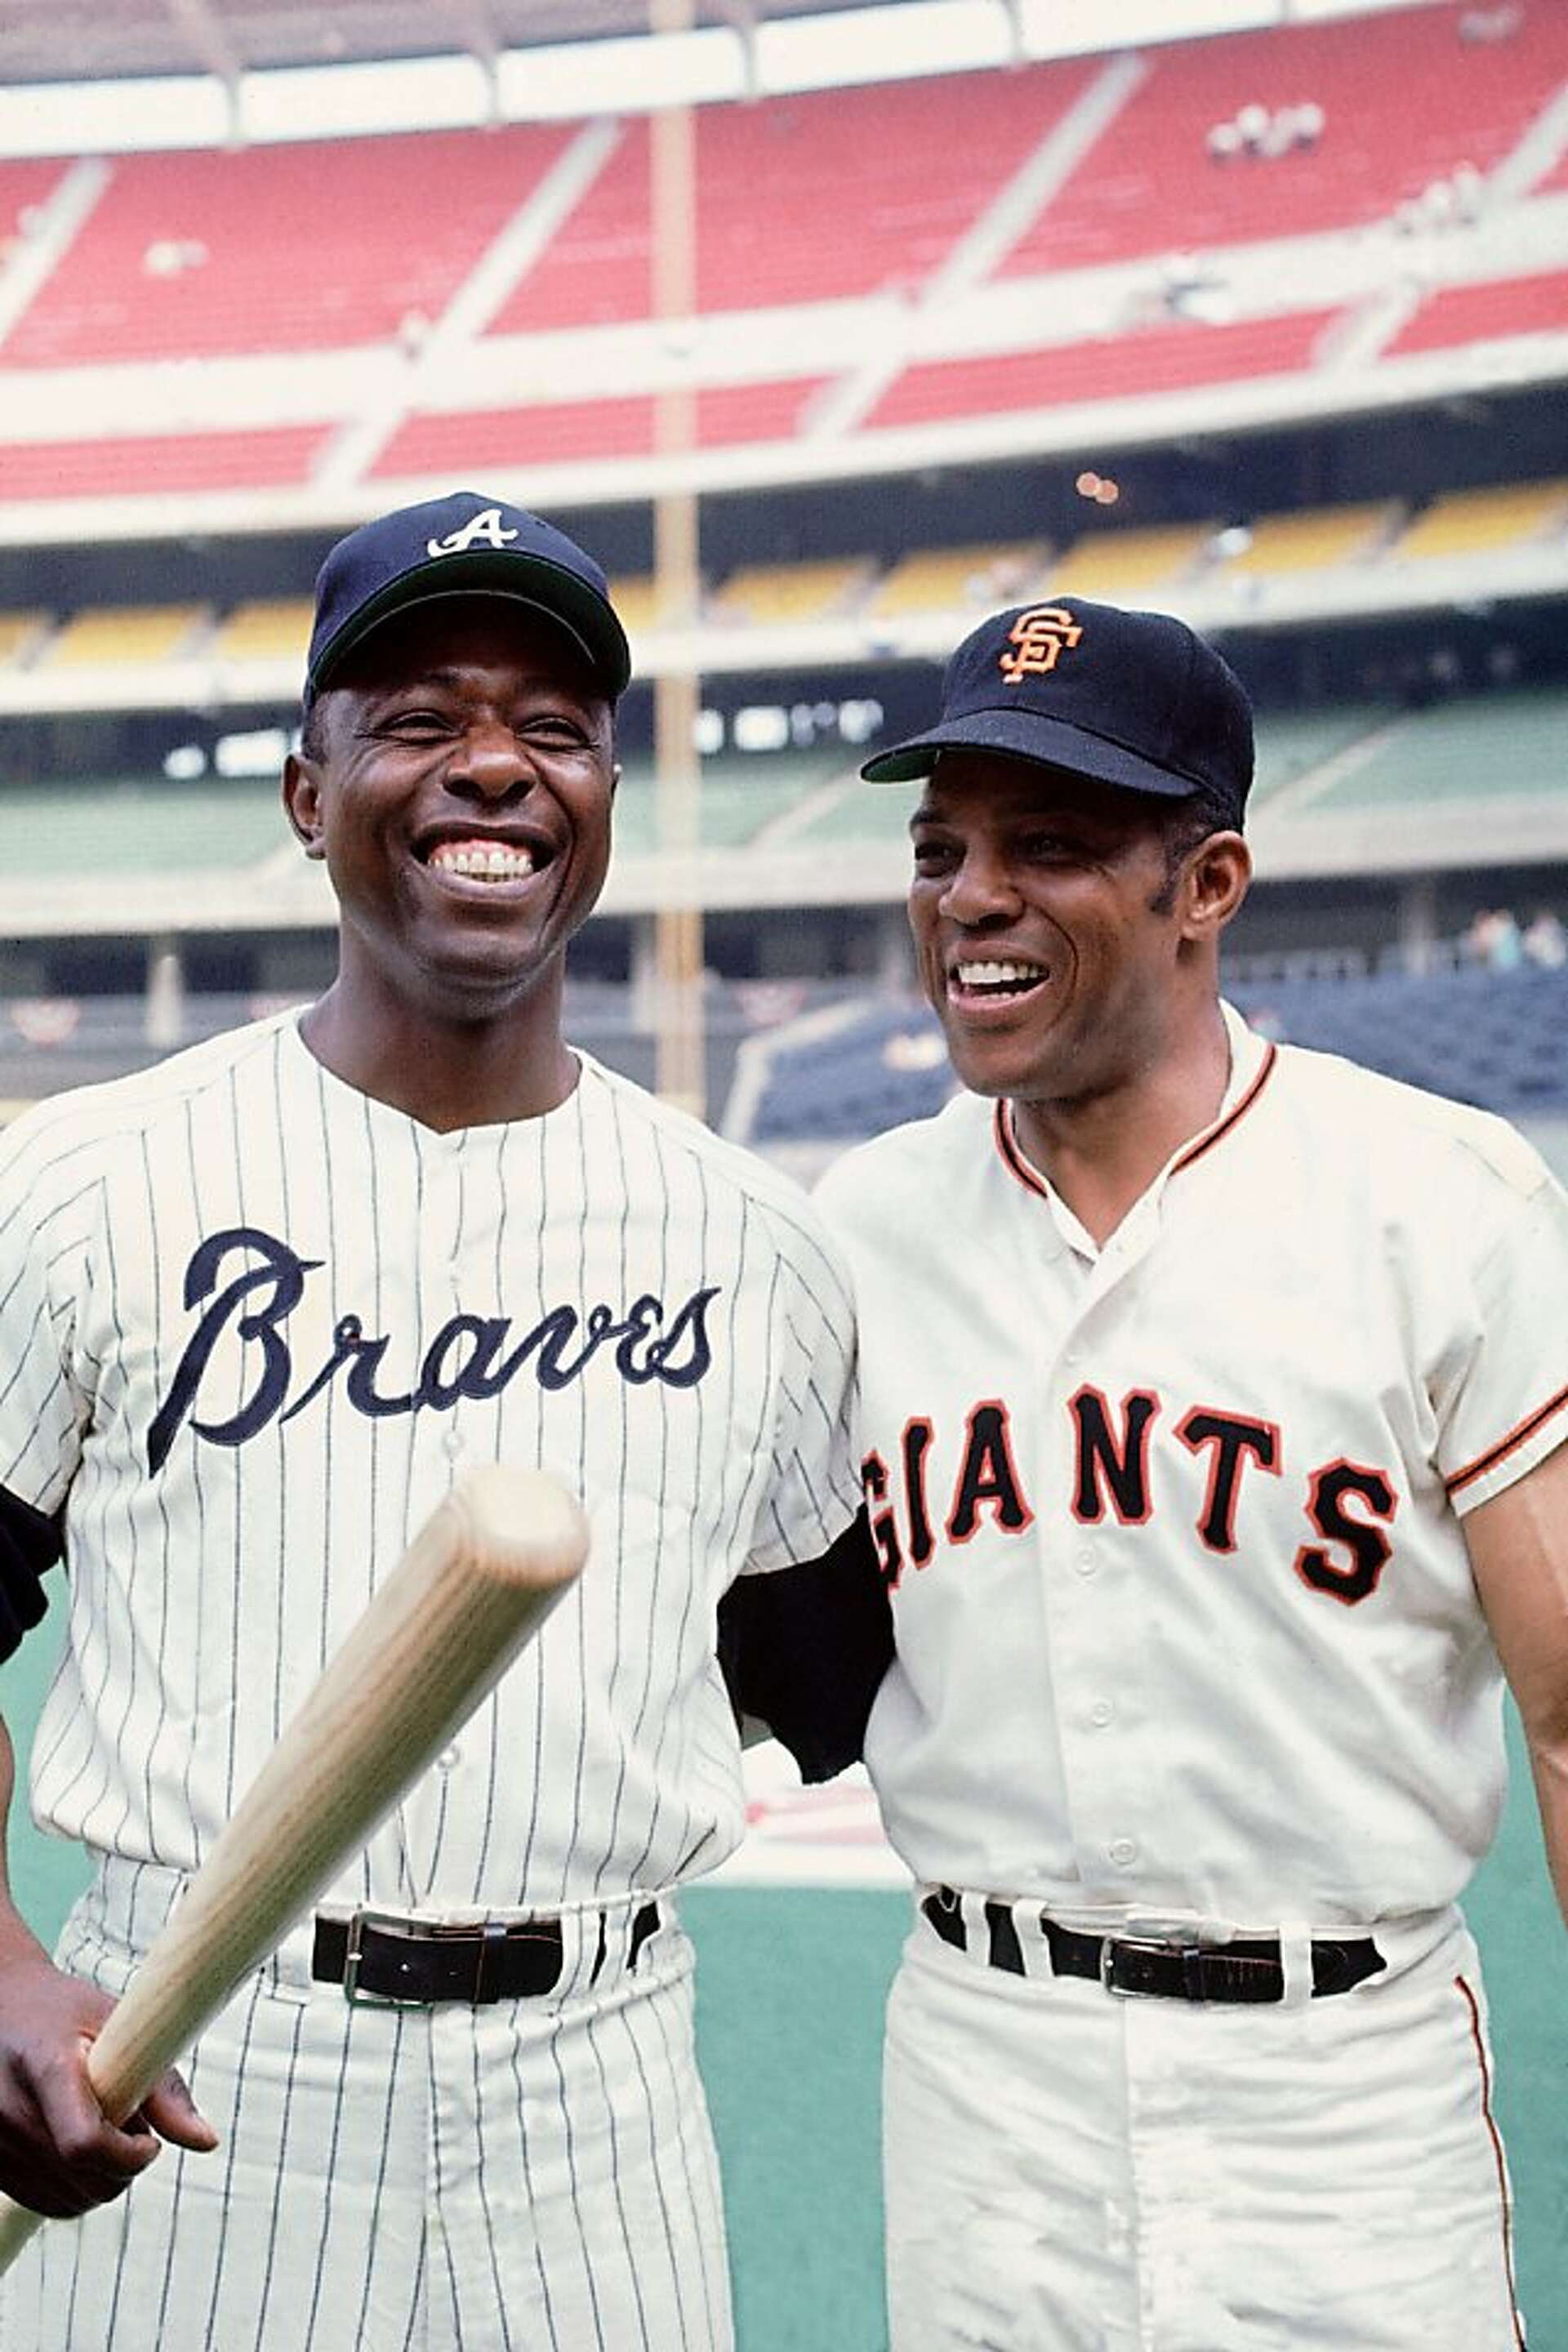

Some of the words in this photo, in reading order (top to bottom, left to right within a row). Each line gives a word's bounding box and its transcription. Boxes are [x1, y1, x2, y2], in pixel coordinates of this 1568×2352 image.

[428, 509, 519, 557] A
[1000, 608, 1084, 684] SF
[146, 1227, 722, 1479] Braves
